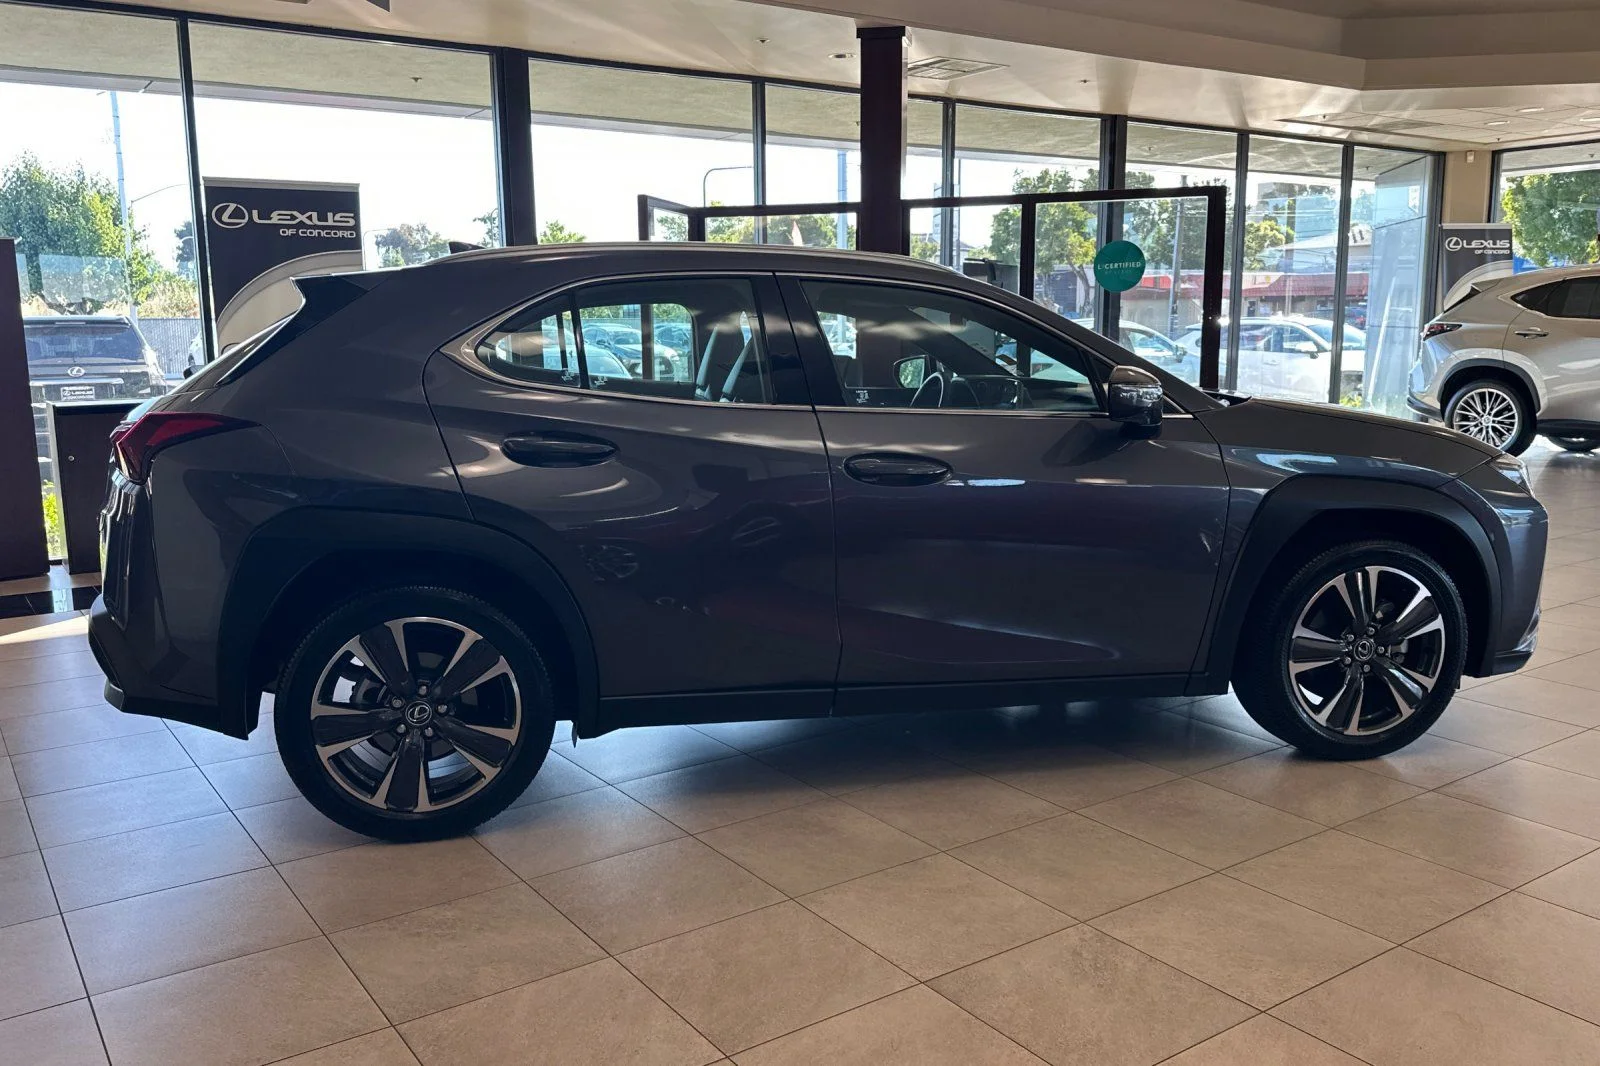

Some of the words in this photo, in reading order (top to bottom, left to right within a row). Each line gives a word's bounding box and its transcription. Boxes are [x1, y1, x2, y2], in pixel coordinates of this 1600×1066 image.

[252, 209, 356, 227] LEXUS
[280, 228, 297, 237] OF
[299, 228, 356, 238] CONCORD
[1463, 240, 1510, 248] LEXUS
